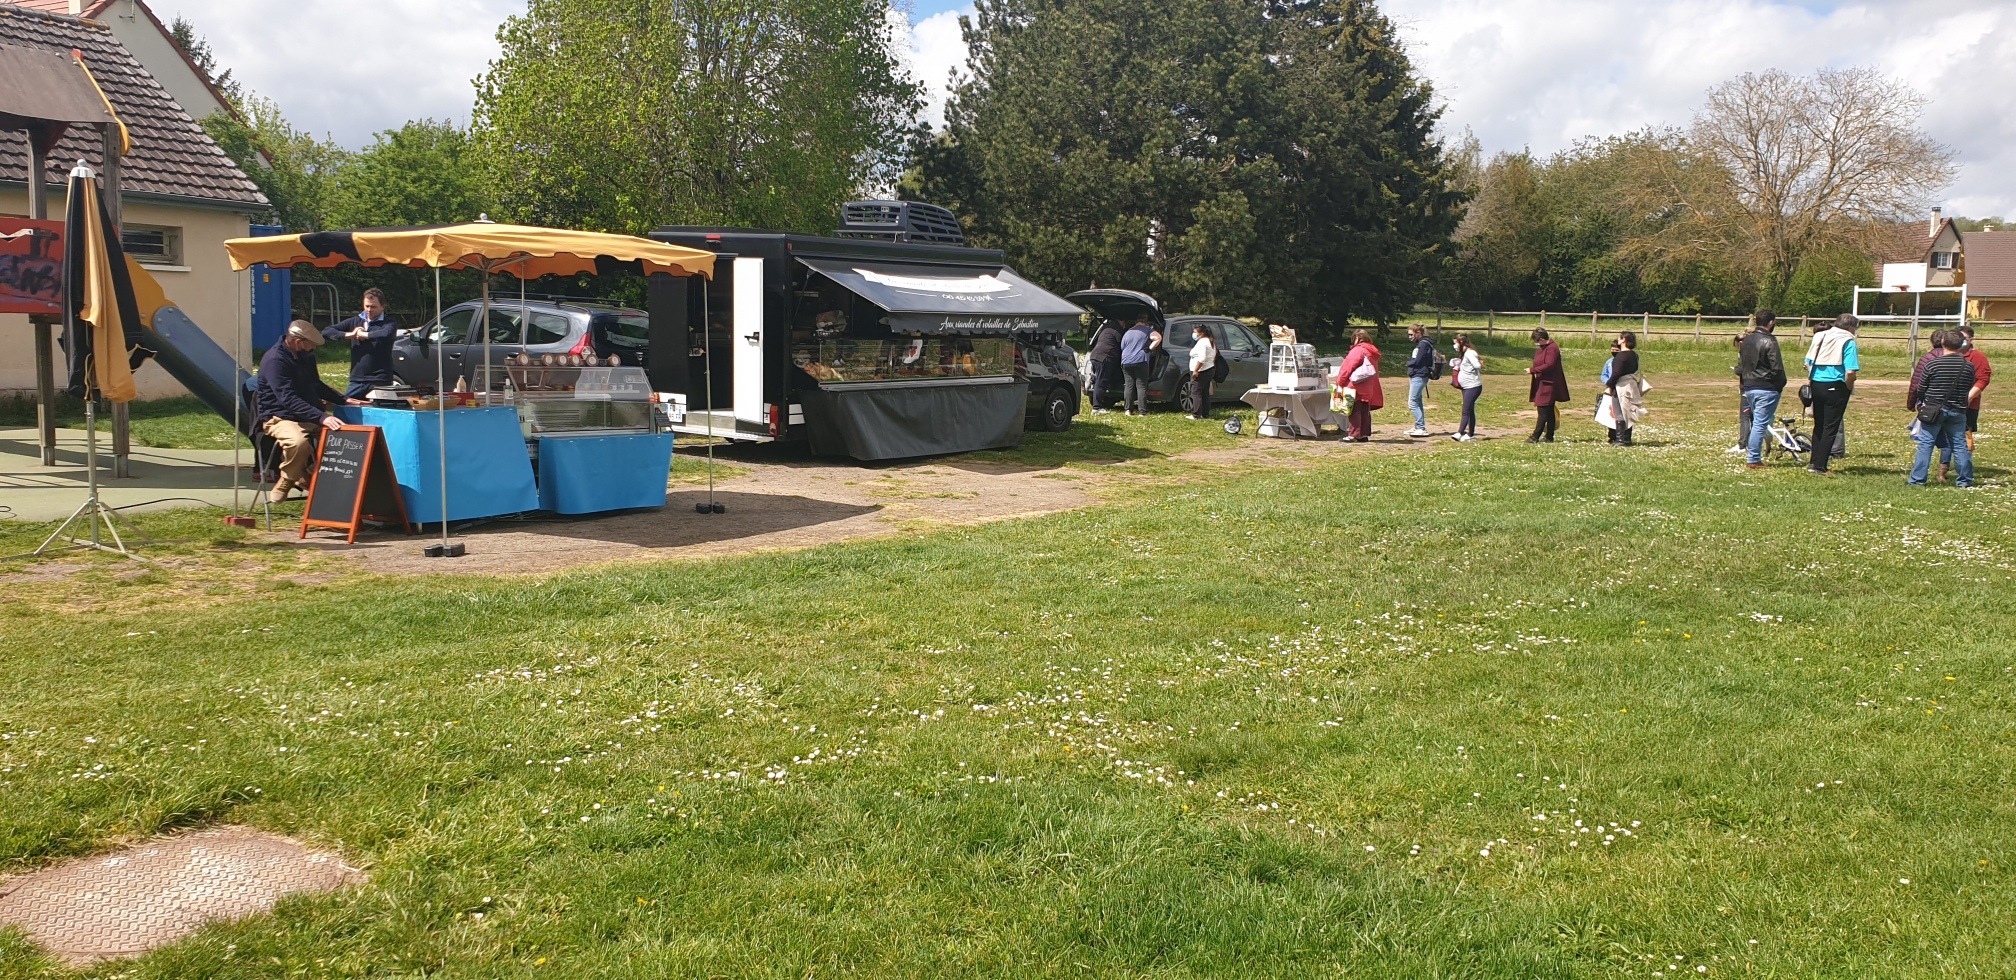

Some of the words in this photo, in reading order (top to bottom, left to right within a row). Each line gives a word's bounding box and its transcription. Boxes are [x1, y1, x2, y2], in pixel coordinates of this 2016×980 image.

[939, 316, 955, 331] Aux
[955, 318, 975, 329] viandes
[976, 319, 983, 329] et
[982, 318, 1004, 329] volailles
[1004, 318, 1011, 329] de
[1012, 317, 1039, 331] Sébastien
